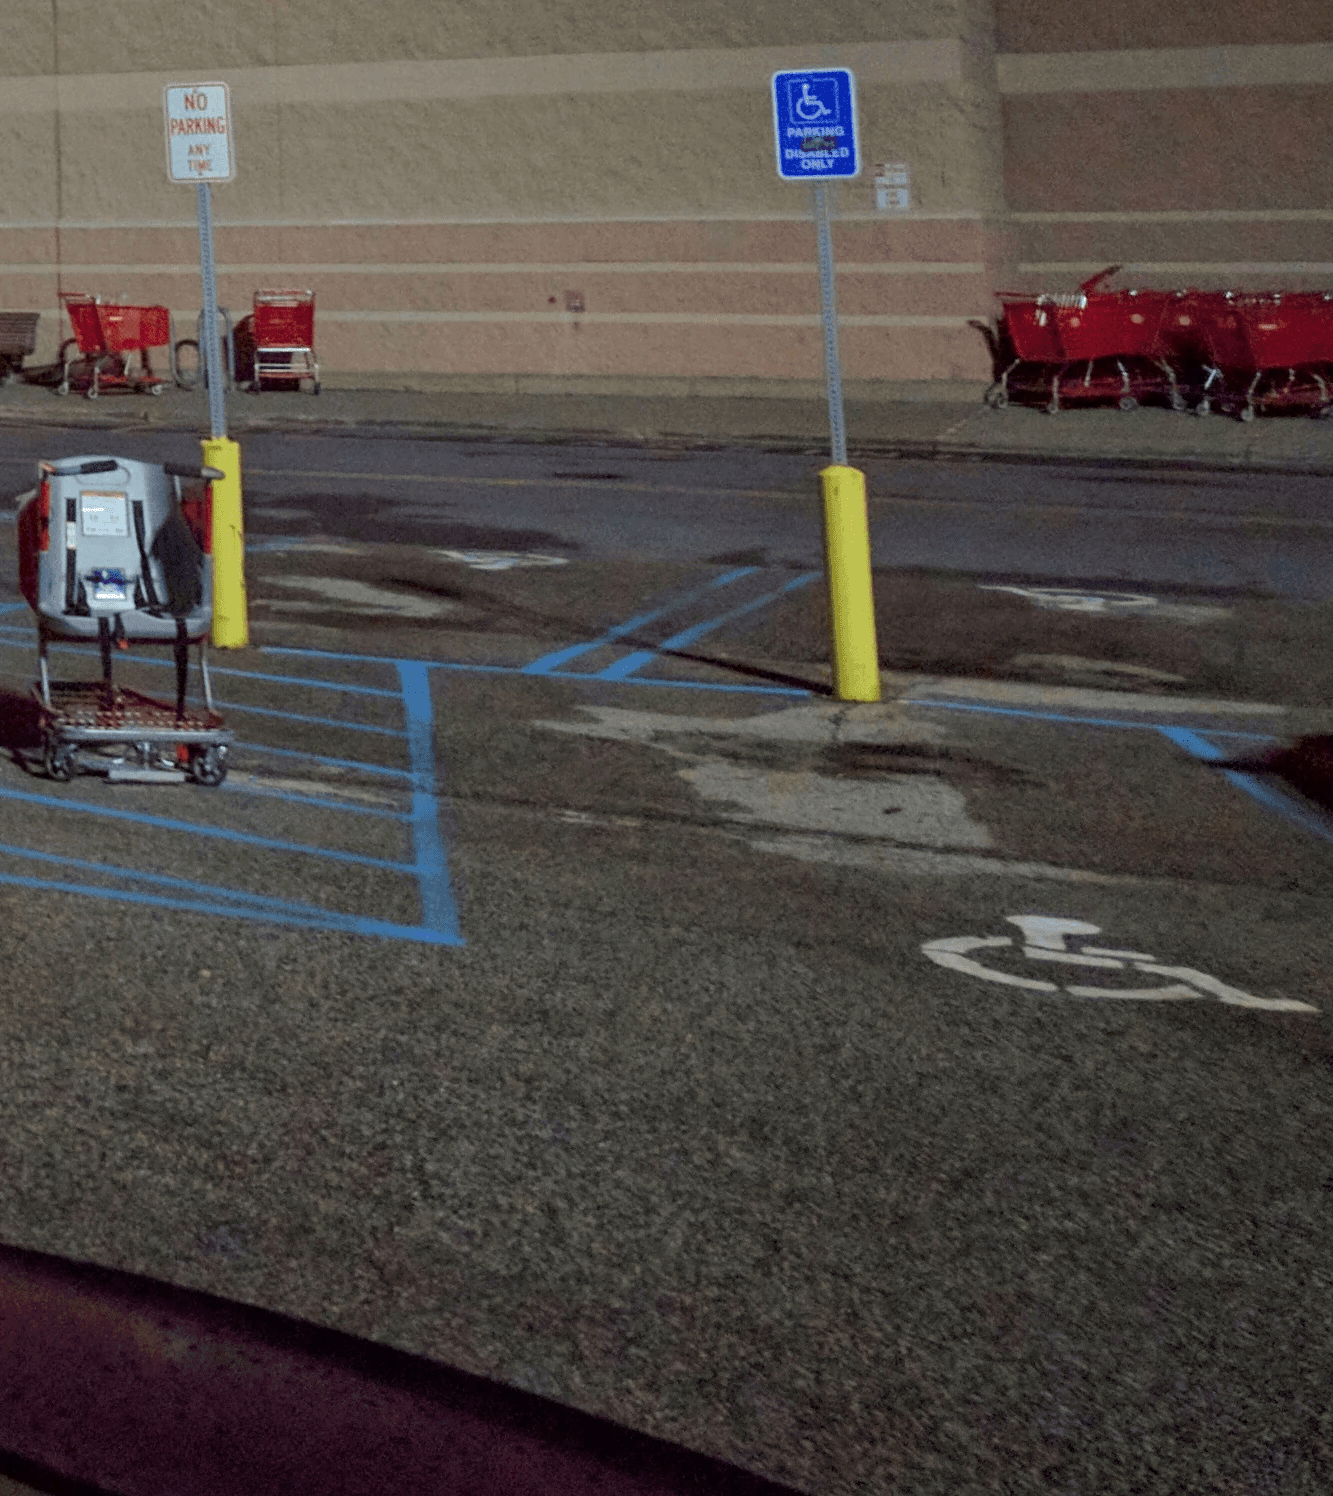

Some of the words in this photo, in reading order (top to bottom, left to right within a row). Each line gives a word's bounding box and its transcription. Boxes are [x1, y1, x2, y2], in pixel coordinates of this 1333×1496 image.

[183, 92, 208, 111] NO
[171, 116, 226, 135] PARKING
[786, 126, 845, 138] PARKING
[187, 144, 211, 156] ANY
[187, 159, 213, 172] TIME
[800, 158, 834, 170] ONLY
